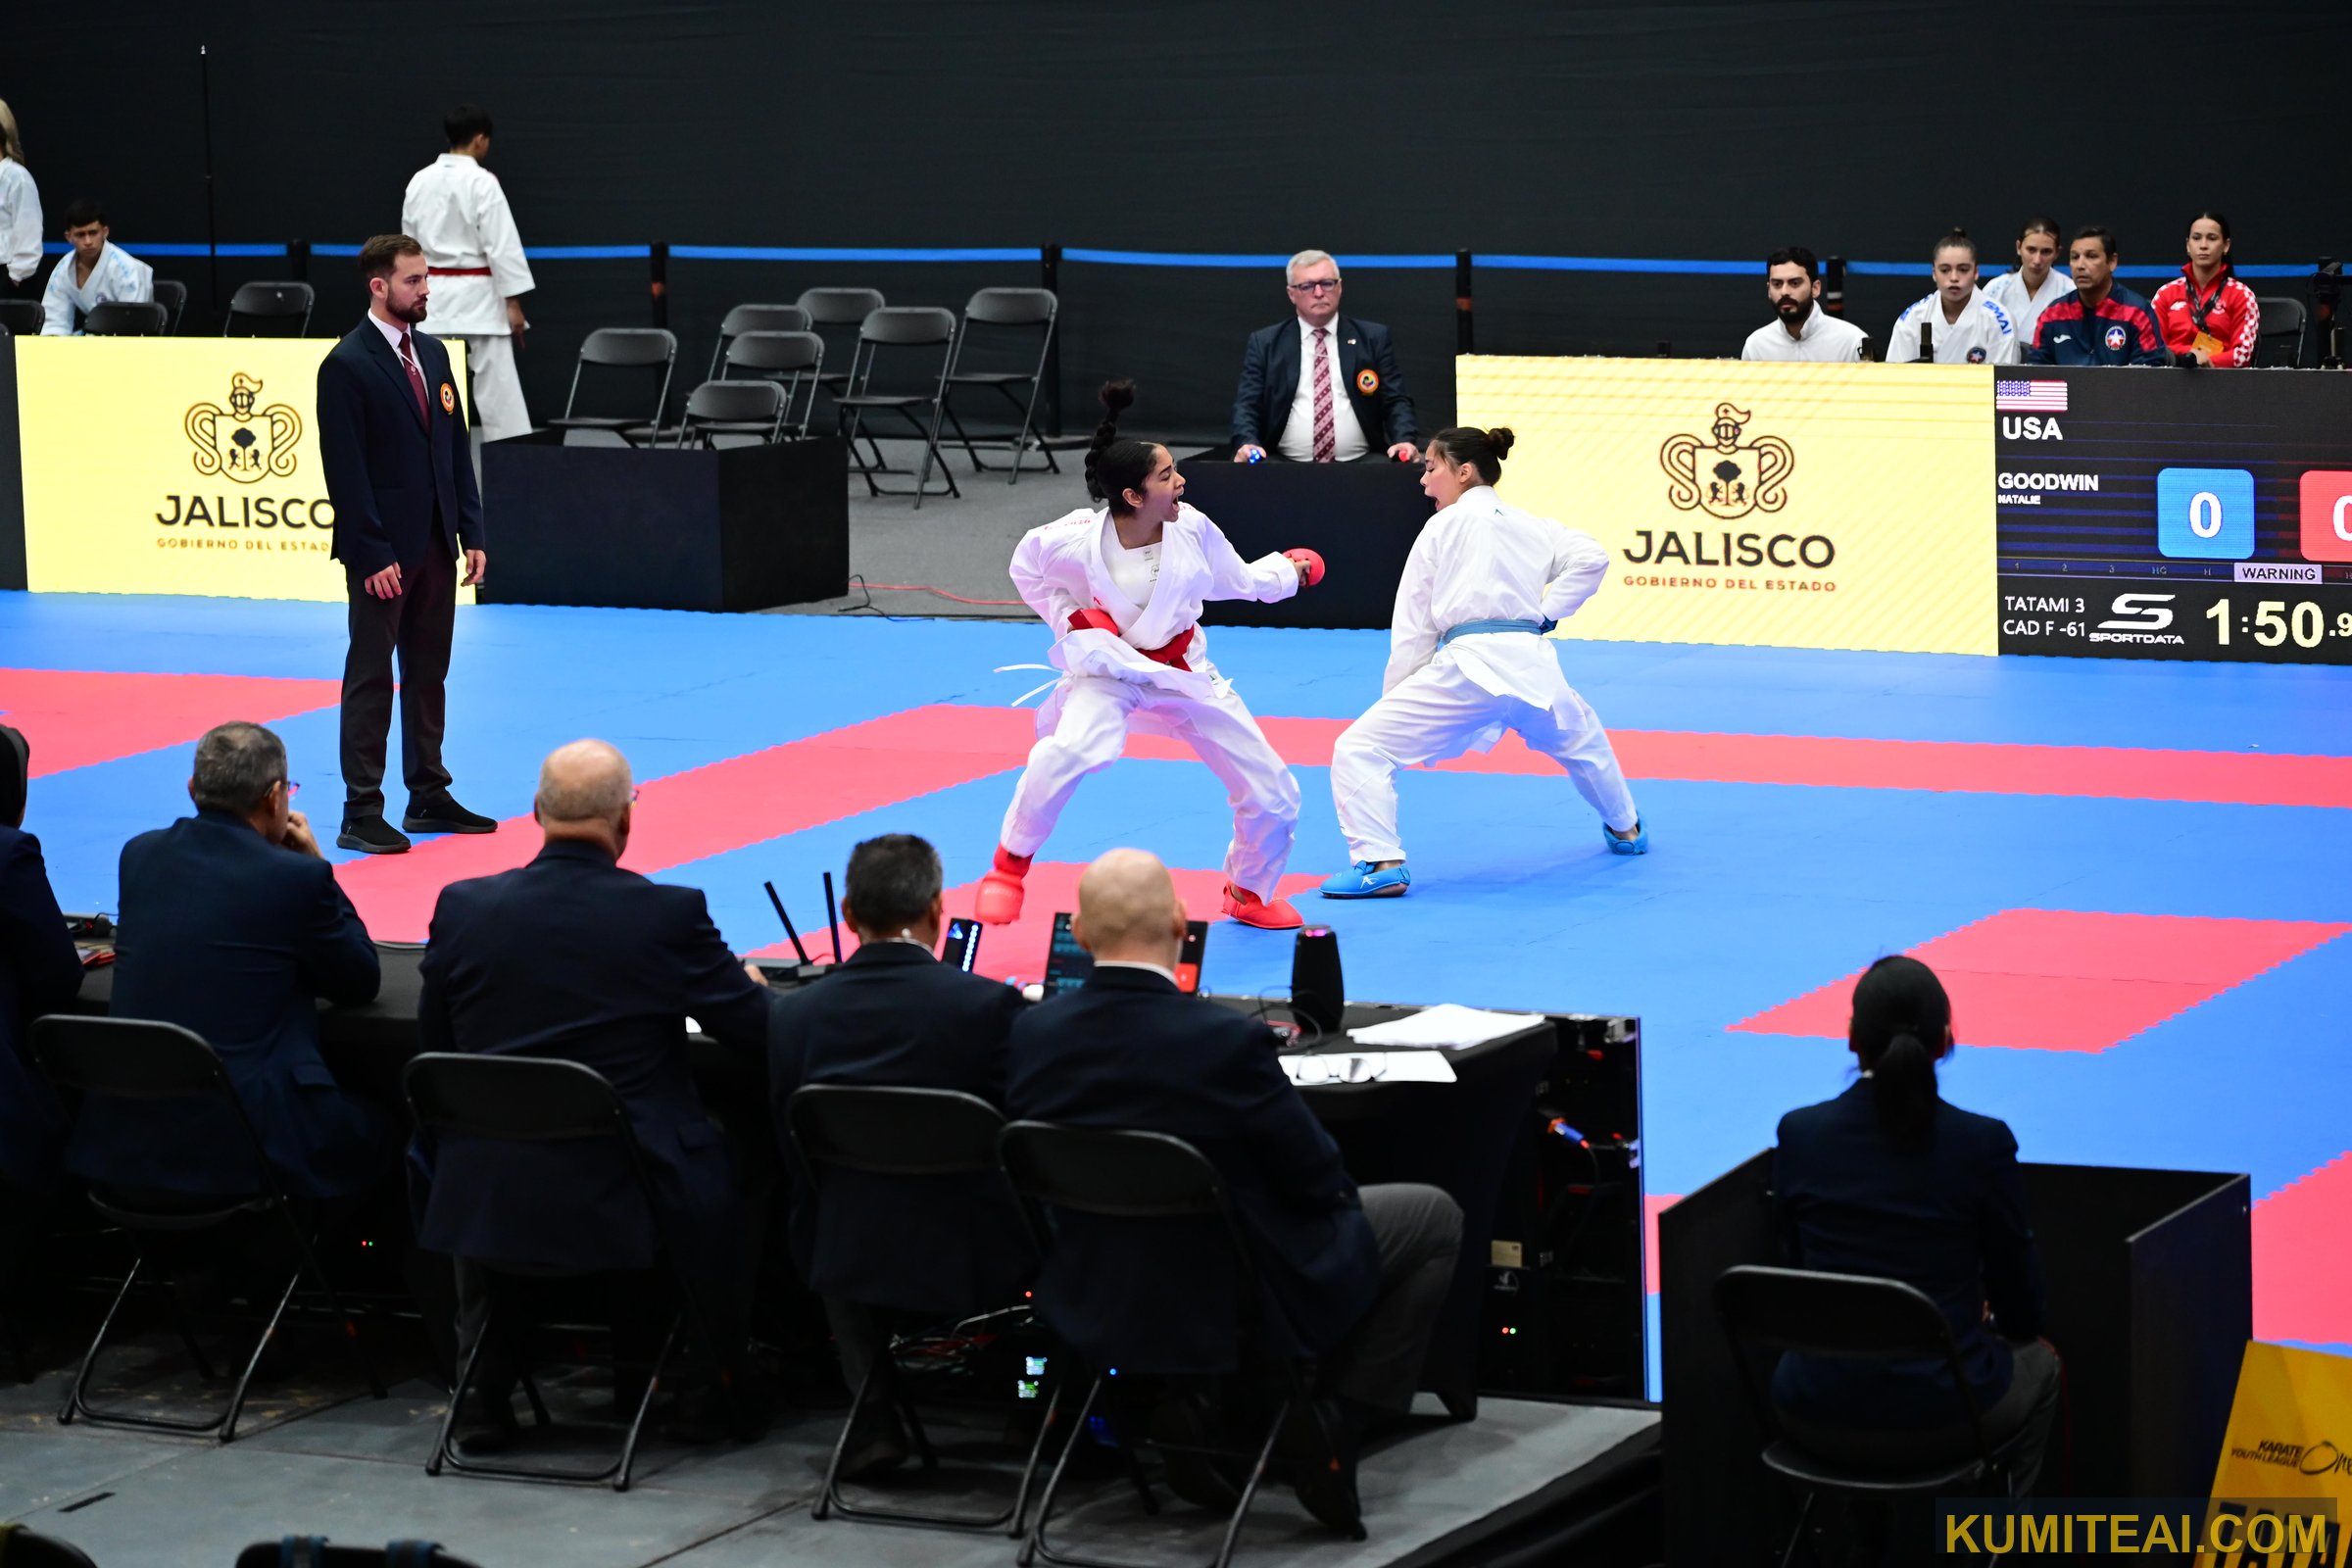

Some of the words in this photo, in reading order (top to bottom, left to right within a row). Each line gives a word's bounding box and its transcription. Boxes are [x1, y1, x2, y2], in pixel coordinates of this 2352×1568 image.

[1984, 300, 2012, 335] SMAI
[2002, 416, 2064, 440] USA
[1997, 472, 2099, 491] GOODWIN
[1997, 494, 2041, 505] NATALIE
[156, 495, 334, 530] JALISCO
[2189, 491, 2223, 539] 0
[157, 538, 238, 550] GOBIERNO
[245, 540, 273, 551] DEL
[280, 541, 330, 552] ESTAD
[1623, 530, 1836, 568] JALISCO
[2242, 567, 2316, 581] WARNING
[1623, 575, 1717, 589] GOBIERNO
[1725, 578, 1757, 590] DEL
[1765, 580, 1837, 592] ESTADO
[2005, 596, 2070, 612] TATAMI
[2075, 598, 2085, 613] 3
[2003, 620, 2040, 635] CAD
[2045, 621, 2055, 636] F
[2059, 622, 2085, 637] -61
[2088, 633, 2185, 645] SPORTDATA
[2258, 1441, 2304, 1457] KARATE
